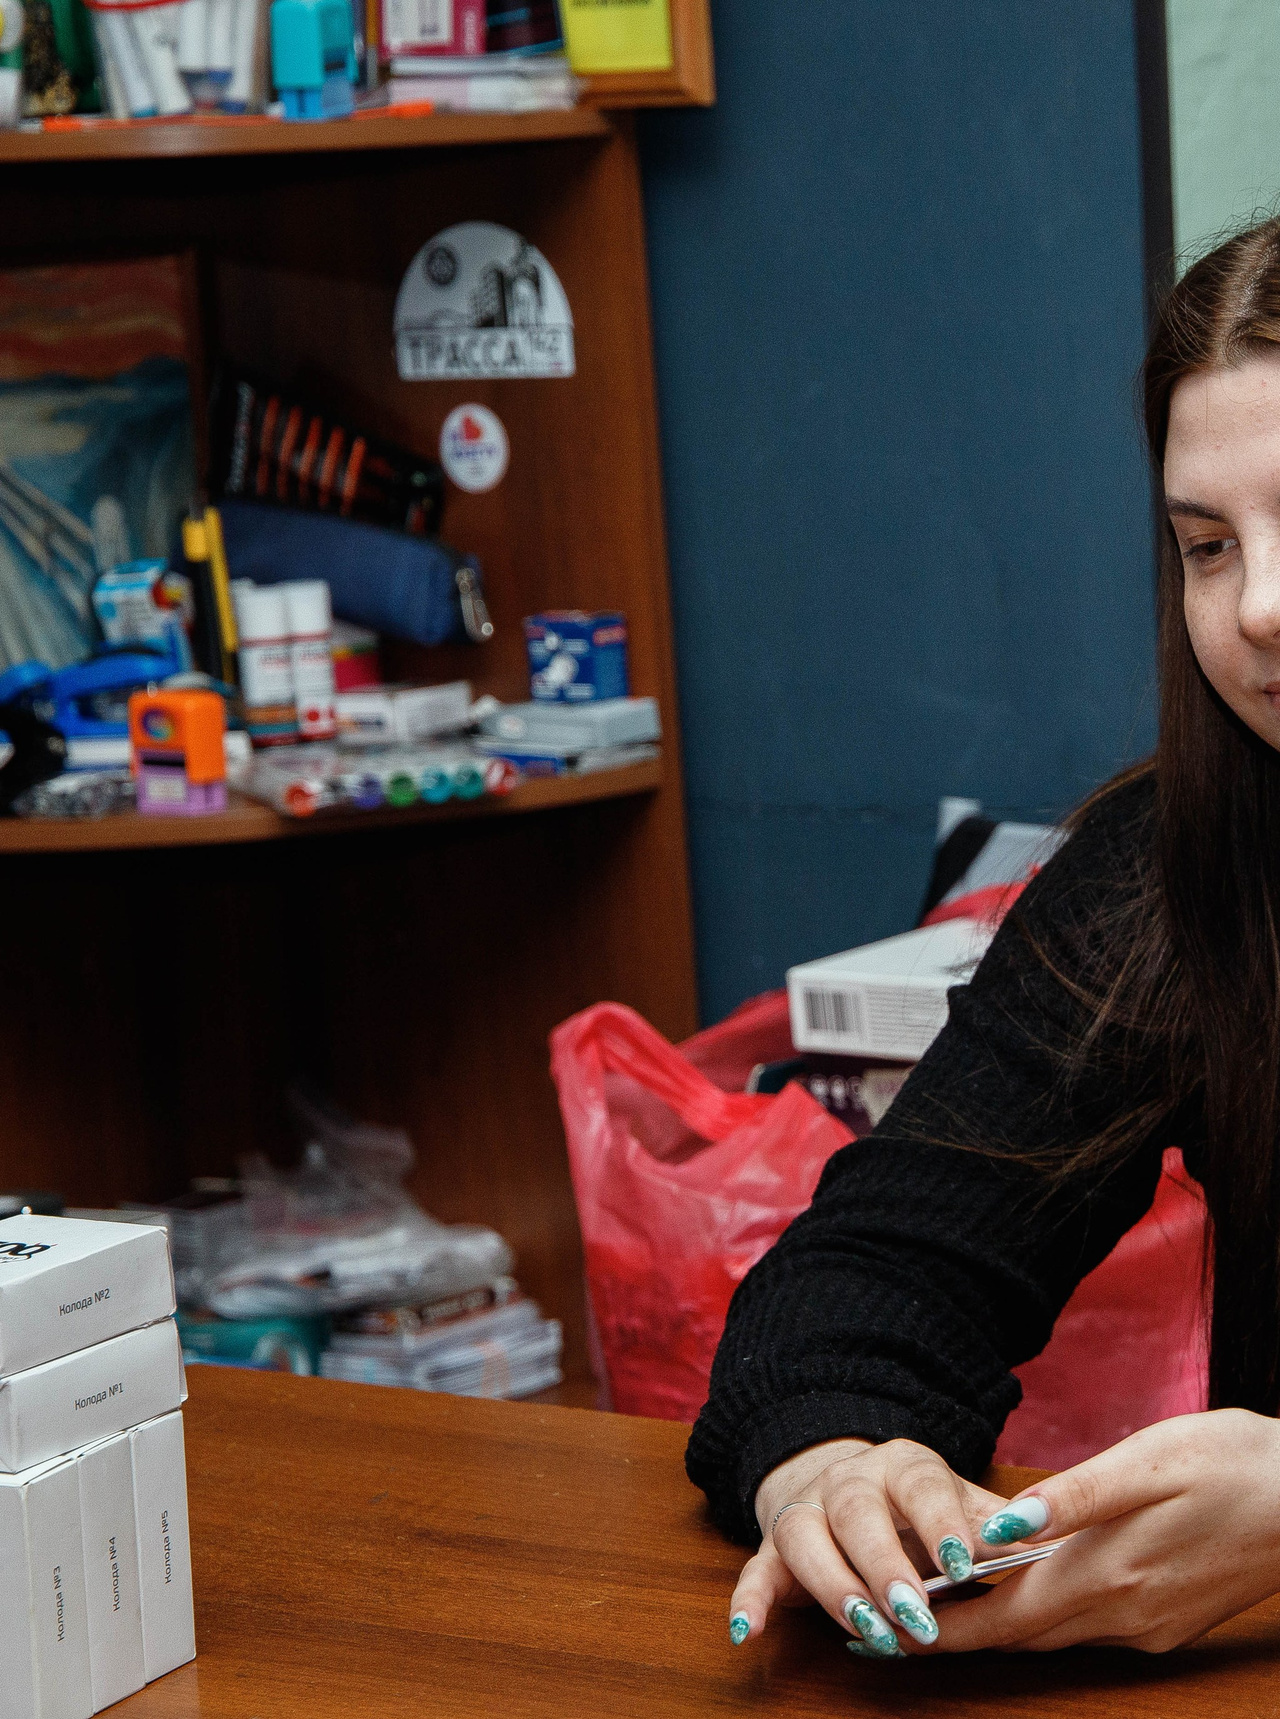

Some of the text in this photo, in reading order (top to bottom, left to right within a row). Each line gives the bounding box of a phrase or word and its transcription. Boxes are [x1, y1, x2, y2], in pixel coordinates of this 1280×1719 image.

[404, 337, 527, 371] ТРАССА
[59, 1288, 110, 1316] Колода №2
[74, 1382, 124, 1411] Колода №1
[108, 1536, 120, 1612] Колода №4
[161, 1509, 172, 1585] Колода №5
[53, 1565, 65, 1642] Колода №3
